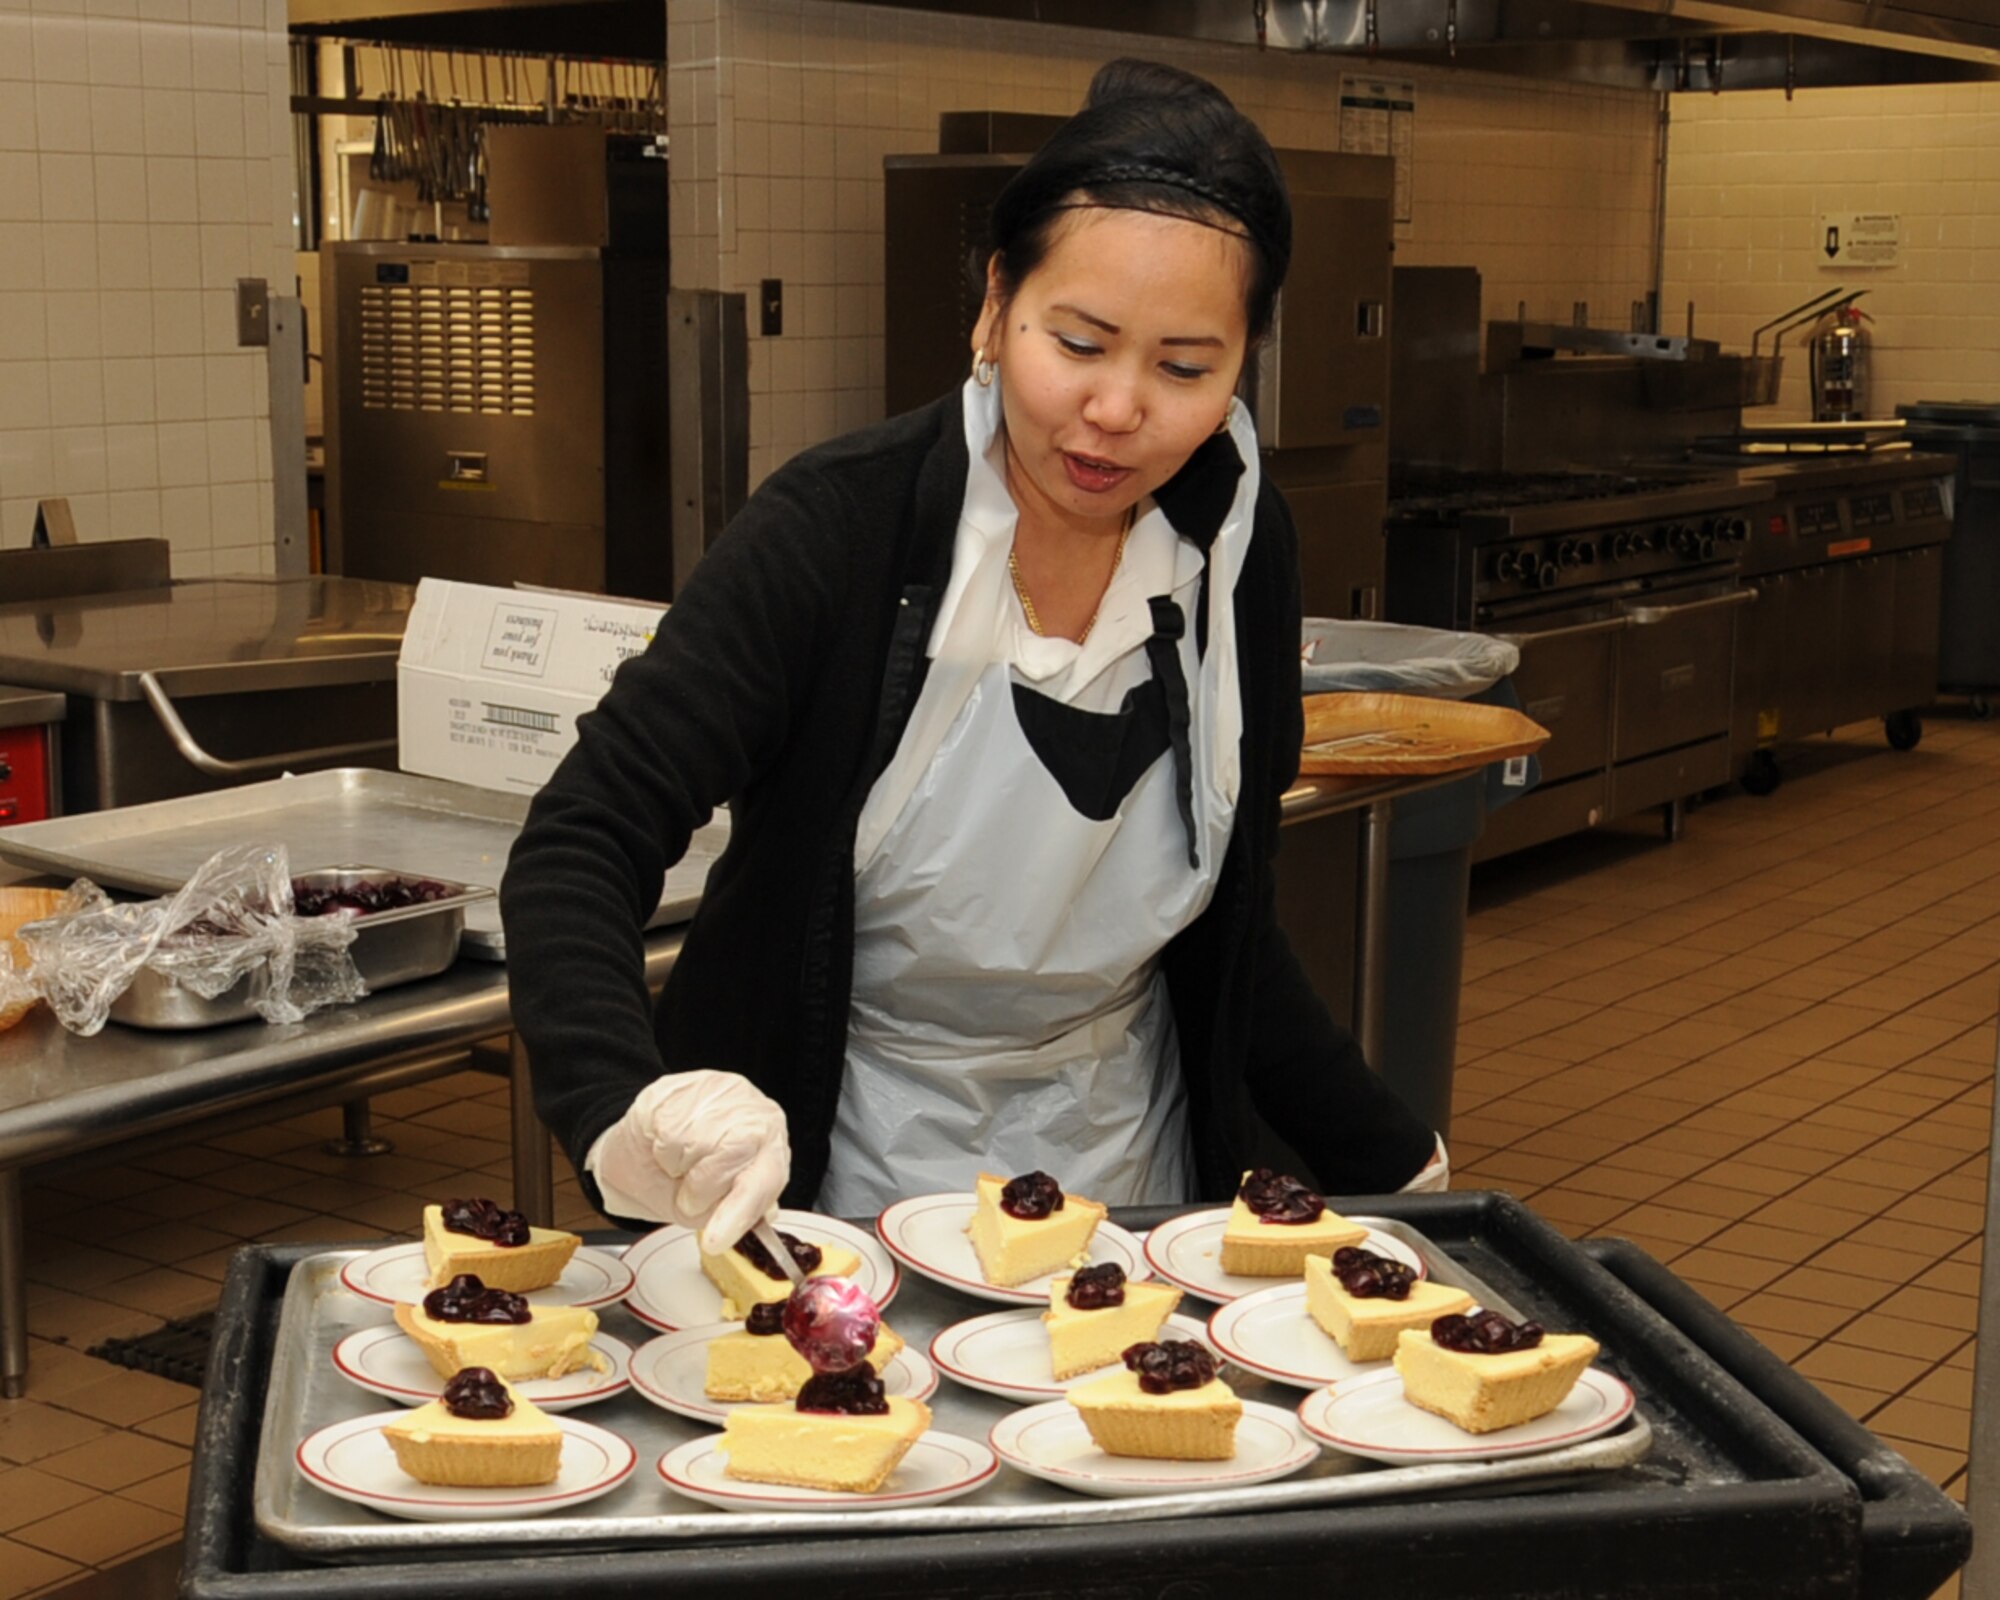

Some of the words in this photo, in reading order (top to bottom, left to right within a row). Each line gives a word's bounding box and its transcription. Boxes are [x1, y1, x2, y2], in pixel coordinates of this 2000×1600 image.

[505, 615, 543, 631] business
[501, 627, 525, 642] your
[523, 632, 542, 648] for
[493, 646, 512, 657] you
[510, 649, 539, 665] Thank
